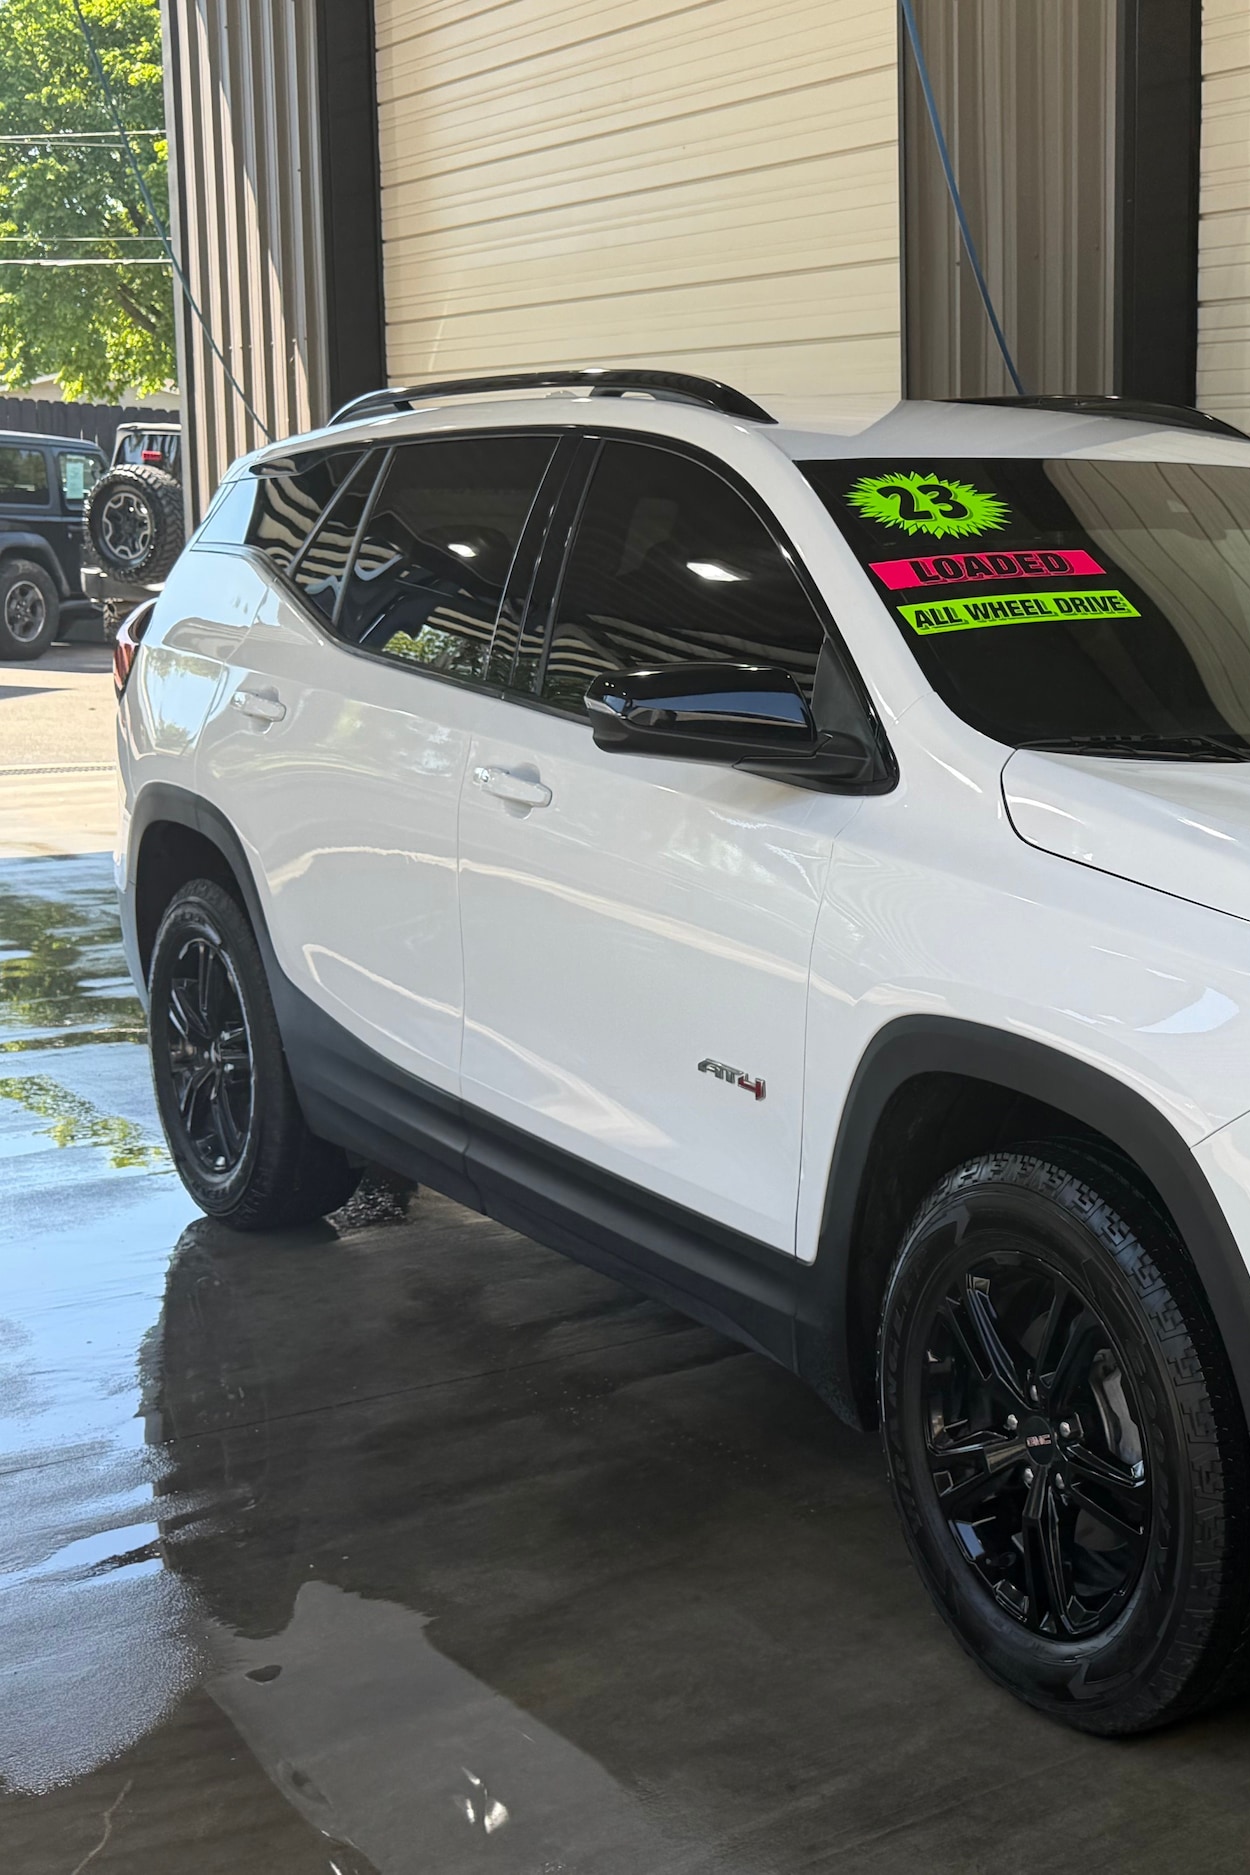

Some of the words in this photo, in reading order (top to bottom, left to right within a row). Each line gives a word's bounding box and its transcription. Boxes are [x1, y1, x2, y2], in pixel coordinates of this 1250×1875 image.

[876, 485, 970, 521] 23
[910, 552, 1074, 584] LOADED
[914, 608, 966, 631] ALL
[963, 600, 1054, 621] WHEEL
[1061, 595, 1130, 616] DRIVE
[697, 1058, 766, 1101] AT4
[1026, 1434, 1052, 1447] GMC
